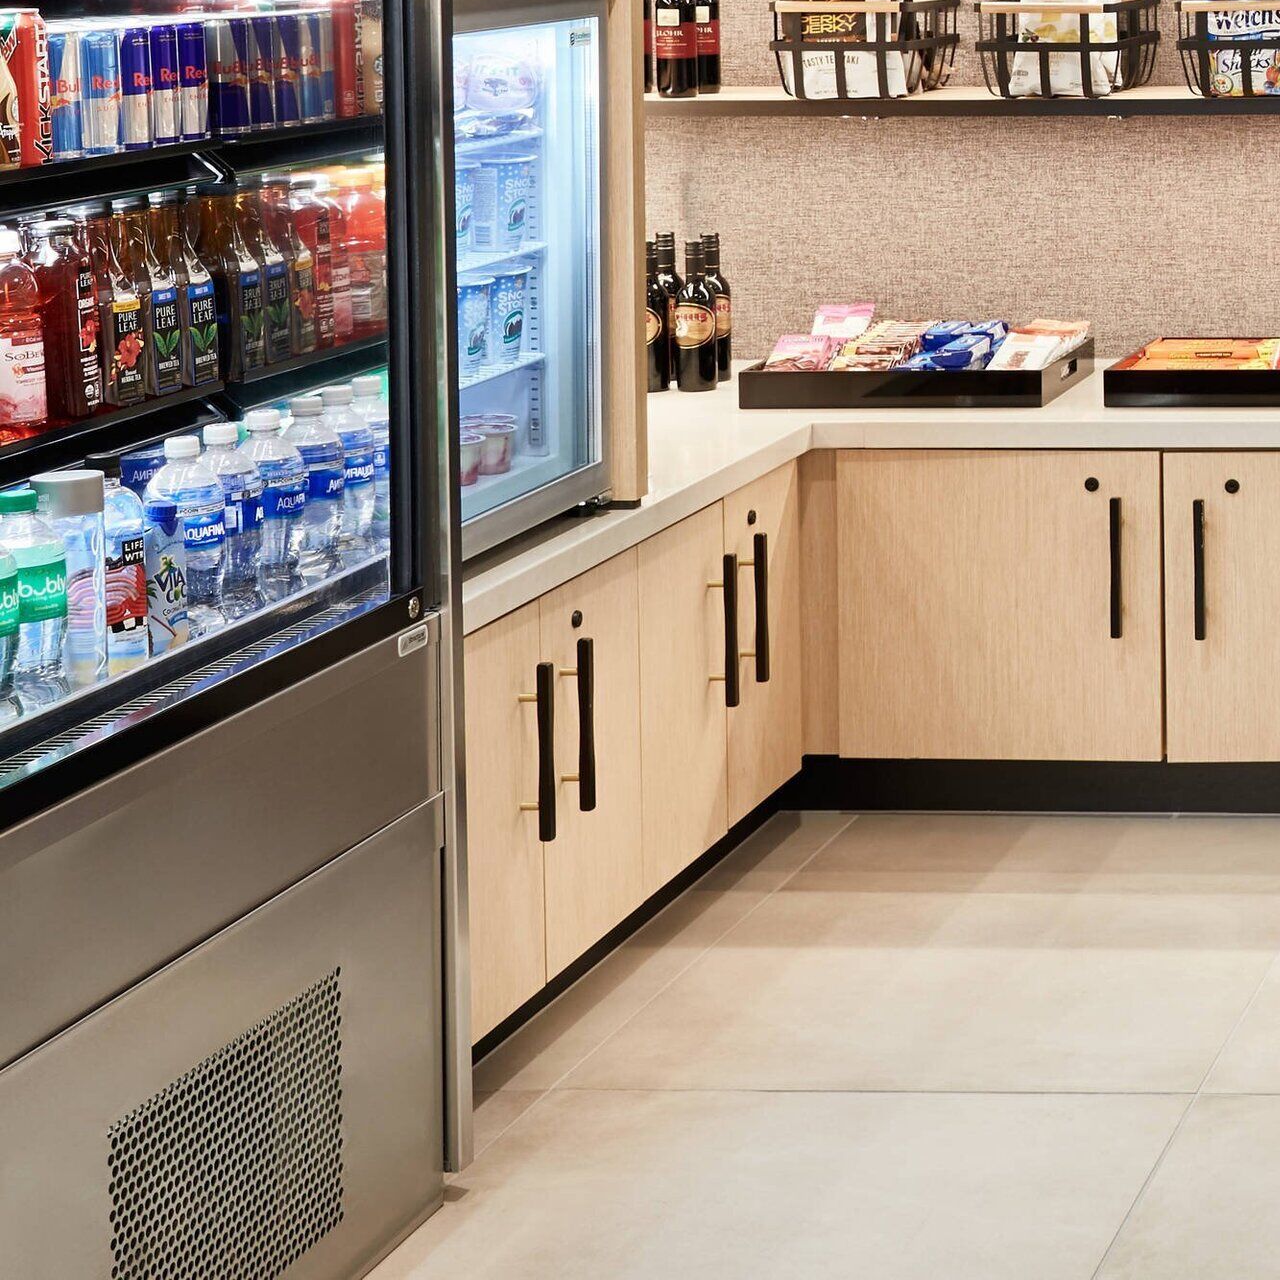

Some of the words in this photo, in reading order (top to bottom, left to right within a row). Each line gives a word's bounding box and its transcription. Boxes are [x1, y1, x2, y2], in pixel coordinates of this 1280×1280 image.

[803, 55, 825, 69] TASTY
[826, 55, 860, 65] TEAKI
[1221, 57, 1271, 73] Sncks
[17, 572, 66, 599] bubly
